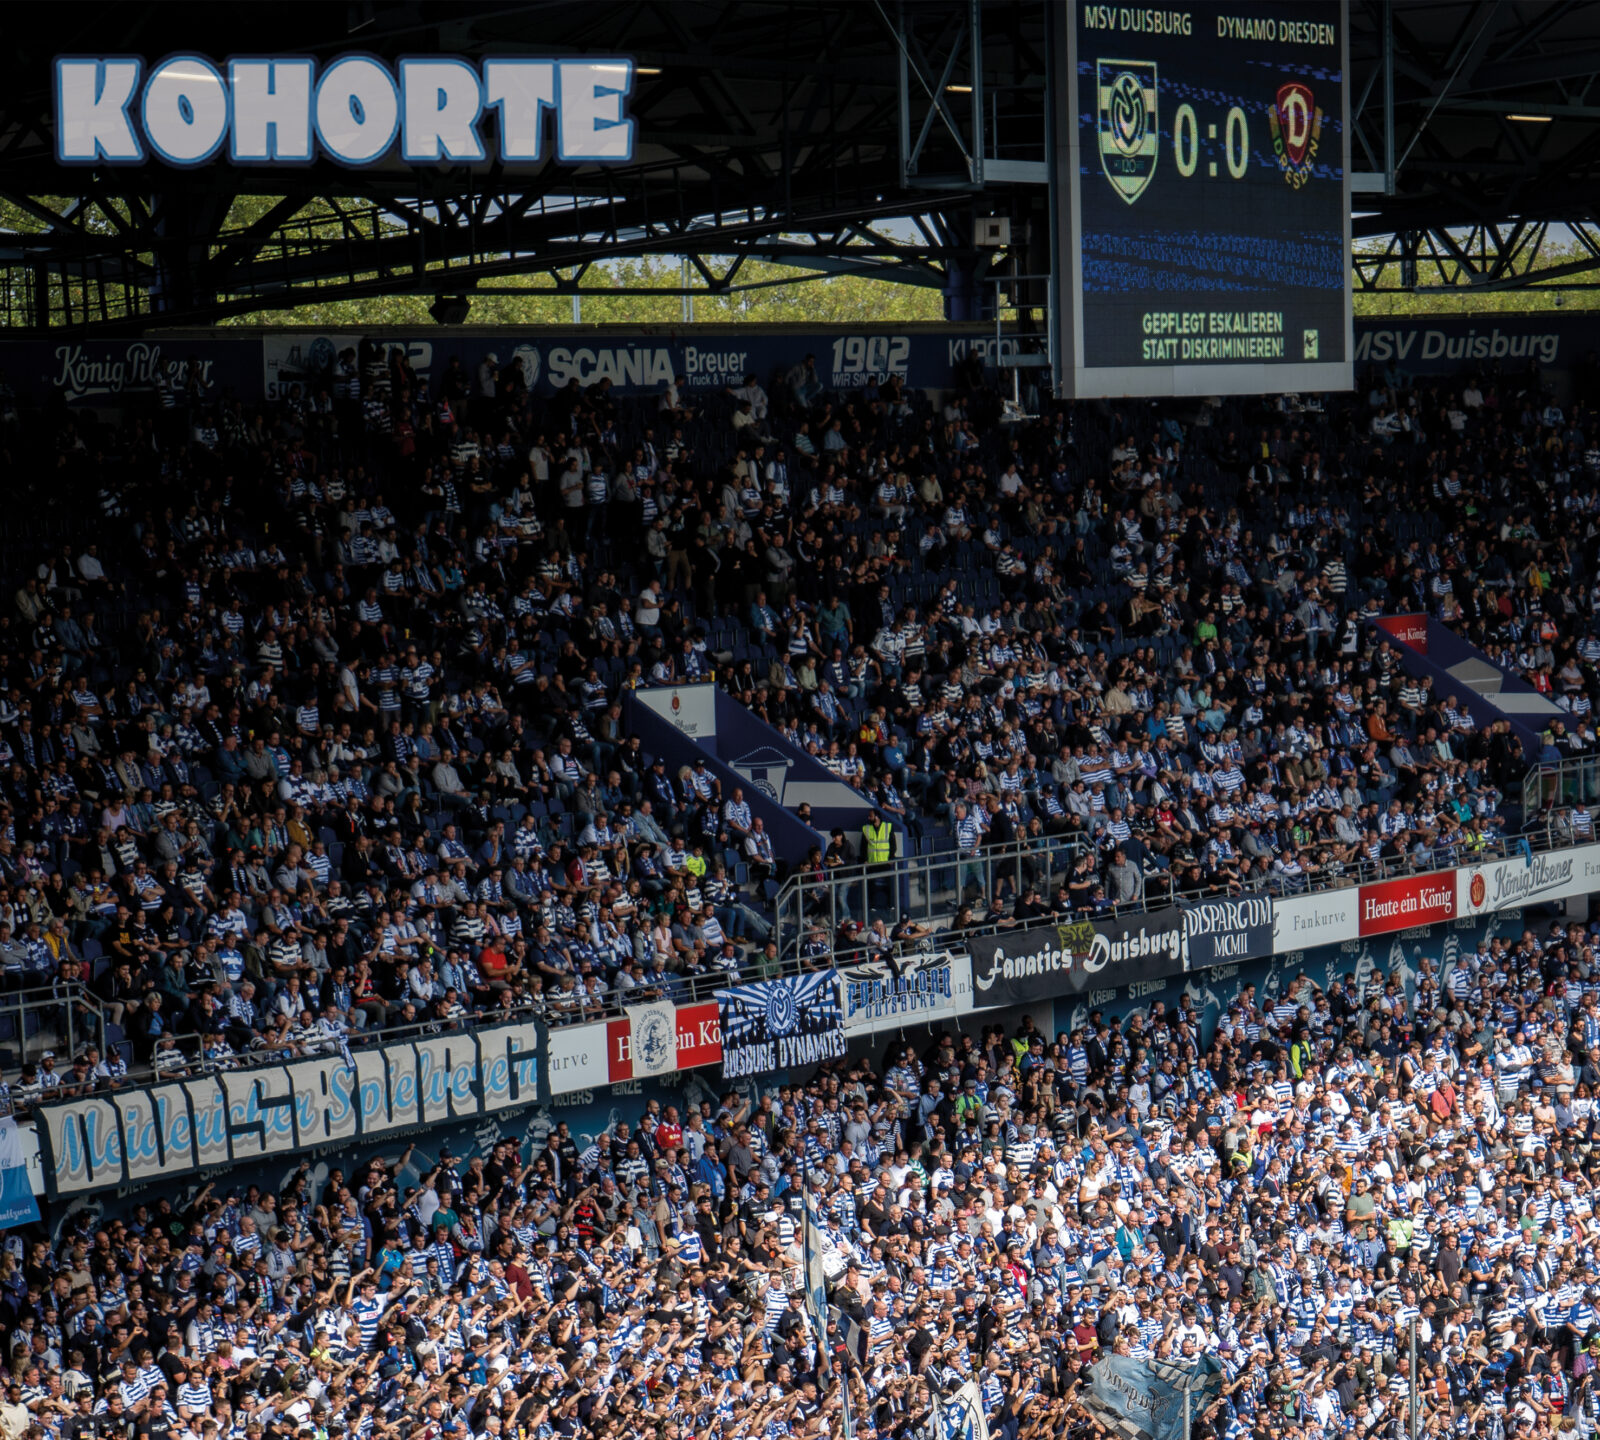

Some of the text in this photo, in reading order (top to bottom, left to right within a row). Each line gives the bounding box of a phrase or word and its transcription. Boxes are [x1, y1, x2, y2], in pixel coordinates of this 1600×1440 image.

[1085, 5, 1192, 36] MSV DUISBURG
[1217, 16, 1335, 45] DYNAMO DRESDEN
[1273, 137, 1319, 190] DRESDEN
[1142, 312, 1283, 334] GEPFLEGT ESKALIEREN
[684, 346, 748, 373] Breuer
[832, 336, 911, 373] 1902
[1143, 337, 1284, 360] STATT DISKRIMINIEREN!
[1421, 328, 1560, 364] Duisburg
[547, 347, 675, 390] SCANIA
[687, 373, 713, 387] Truck
[722, 371, 748, 386] Traile
[832, 372, 850, 387] WIR
[1407, 627, 1428, 643] König
[1493, 855, 1574, 902] König Pilsener
[1184, 896, 1273, 938] DISPARGUM
[1364, 886, 1452, 920] Heute ein König
[1294, 910, 1347, 931] Fankurve
[976, 925, 1181, 992] Fanatics Duisburg
[1214, 932, 1248, 957] MCMII
[778, 1027, 847, 1069] DYNAMITES
[56, 1083, 313, 1188] Meidericher
[326, 1041, 538, 1136] Spielverein
